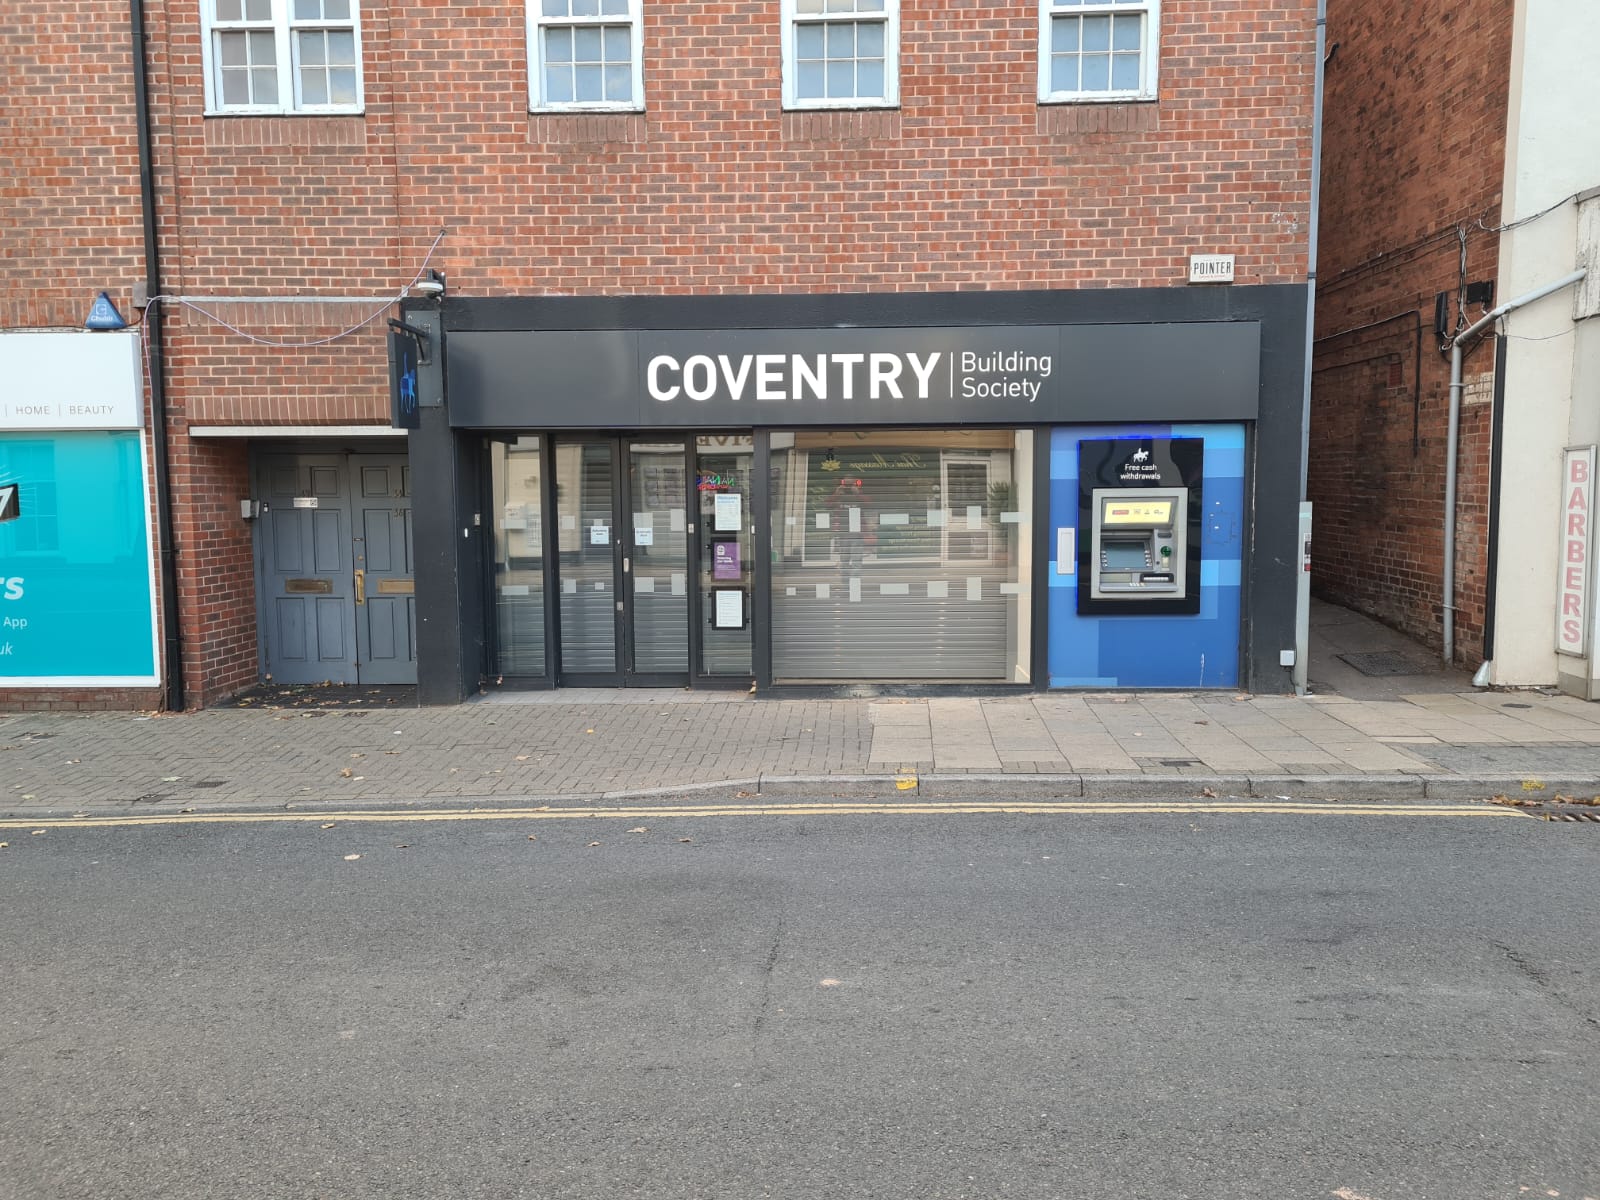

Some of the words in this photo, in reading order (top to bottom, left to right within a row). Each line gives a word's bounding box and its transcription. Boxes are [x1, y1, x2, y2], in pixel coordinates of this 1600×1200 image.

[1194, 262, 1231, 275] POINTER
[961, 351, 1051, 377] Building
[647, 352, 941, 401] COVENTRY
[961, 377, 1041, 402] Society
[15, 405, 50, 415] HOME
[69, 405, 114, 415] BEAUTY
[1124, 463, 1140, 471] Free
[1120, 472, 1161, 480] withdrawals
[1563, 459, 1588, 644] BARBERS
[3, 616, 28, 630] App
